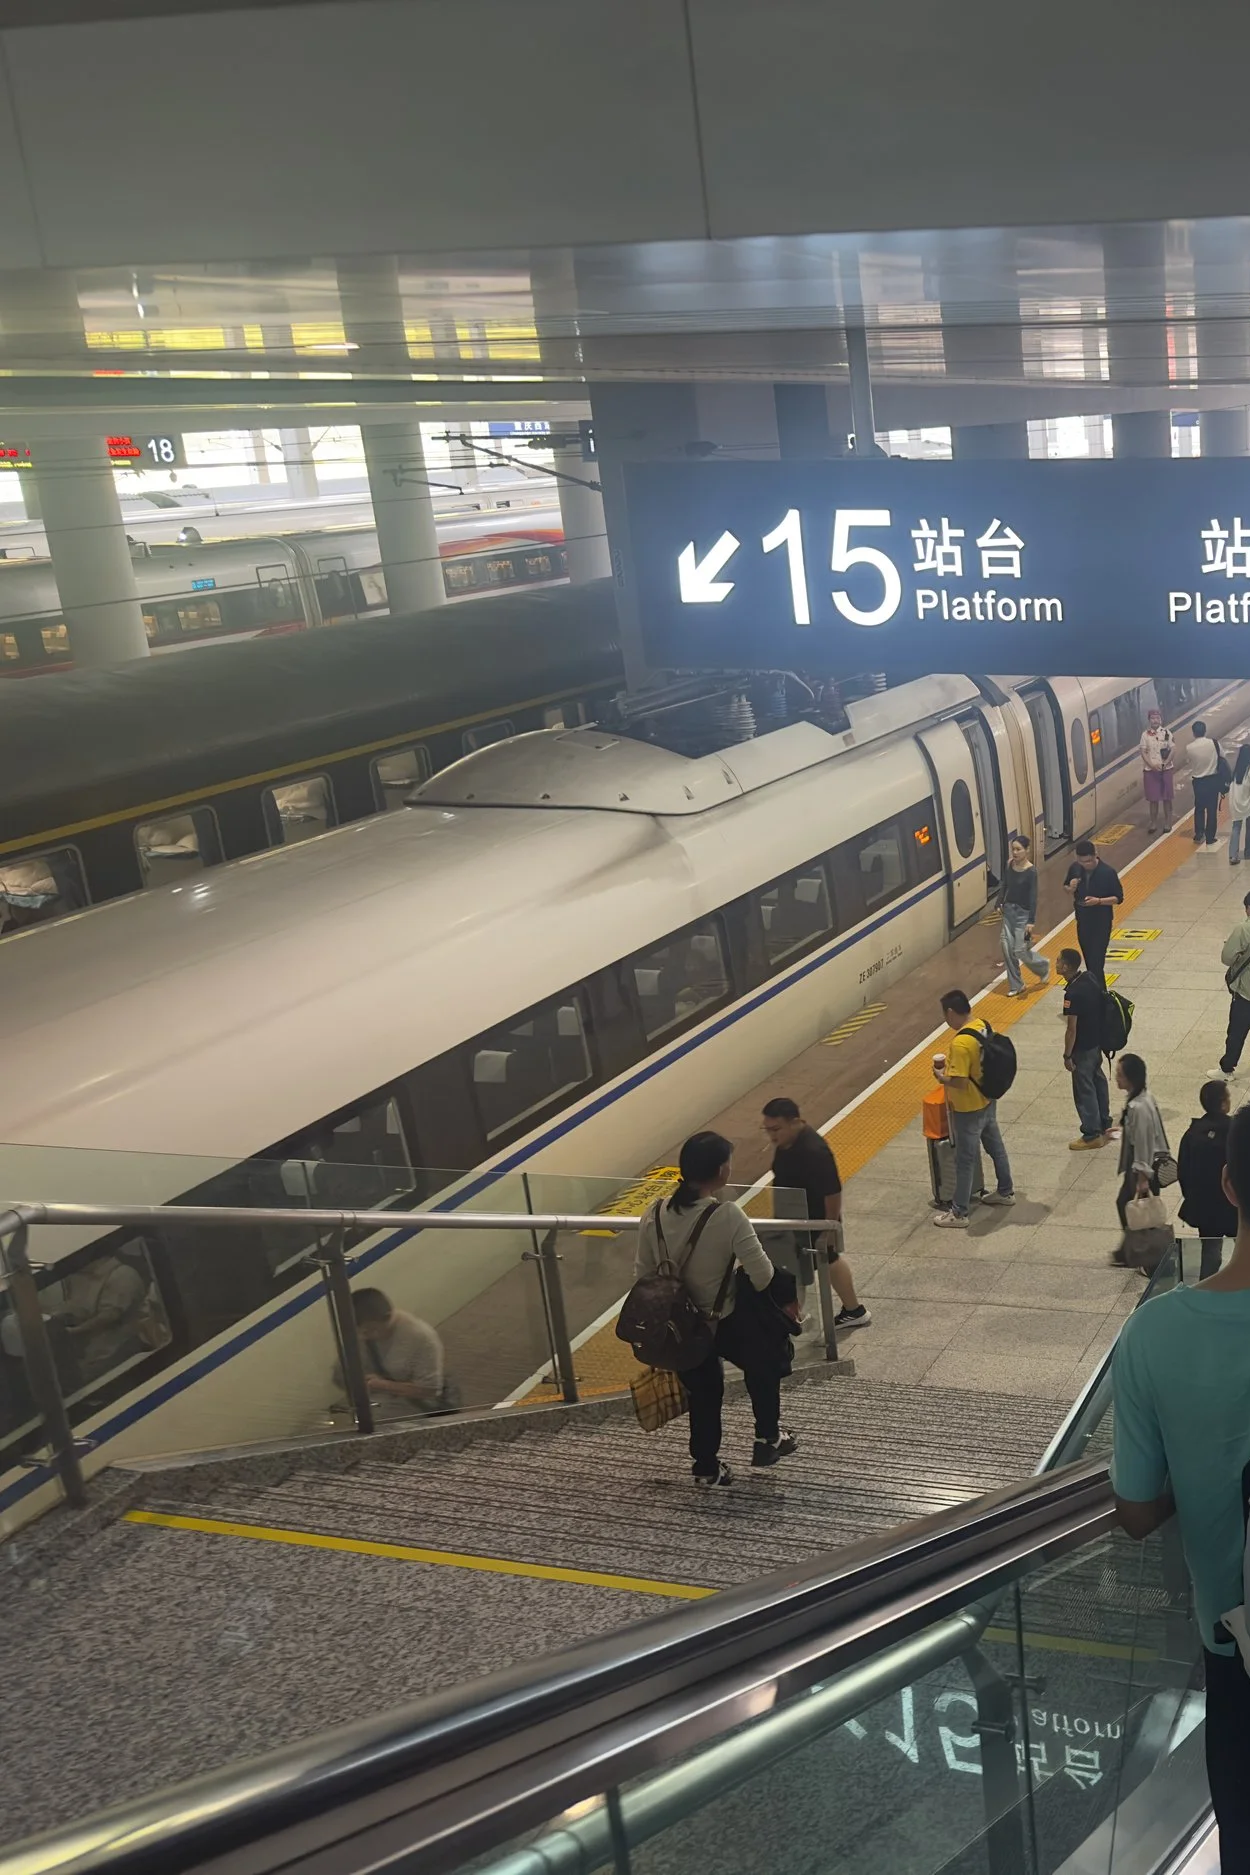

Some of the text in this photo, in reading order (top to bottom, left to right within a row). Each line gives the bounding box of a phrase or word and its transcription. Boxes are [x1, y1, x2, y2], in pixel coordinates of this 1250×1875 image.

[147, 438, 175, 463] 18
[761, 508, 902, 627] 15
[911, 517, 1026, 579] 站台
[916, 588, 1064, 623] Platform
